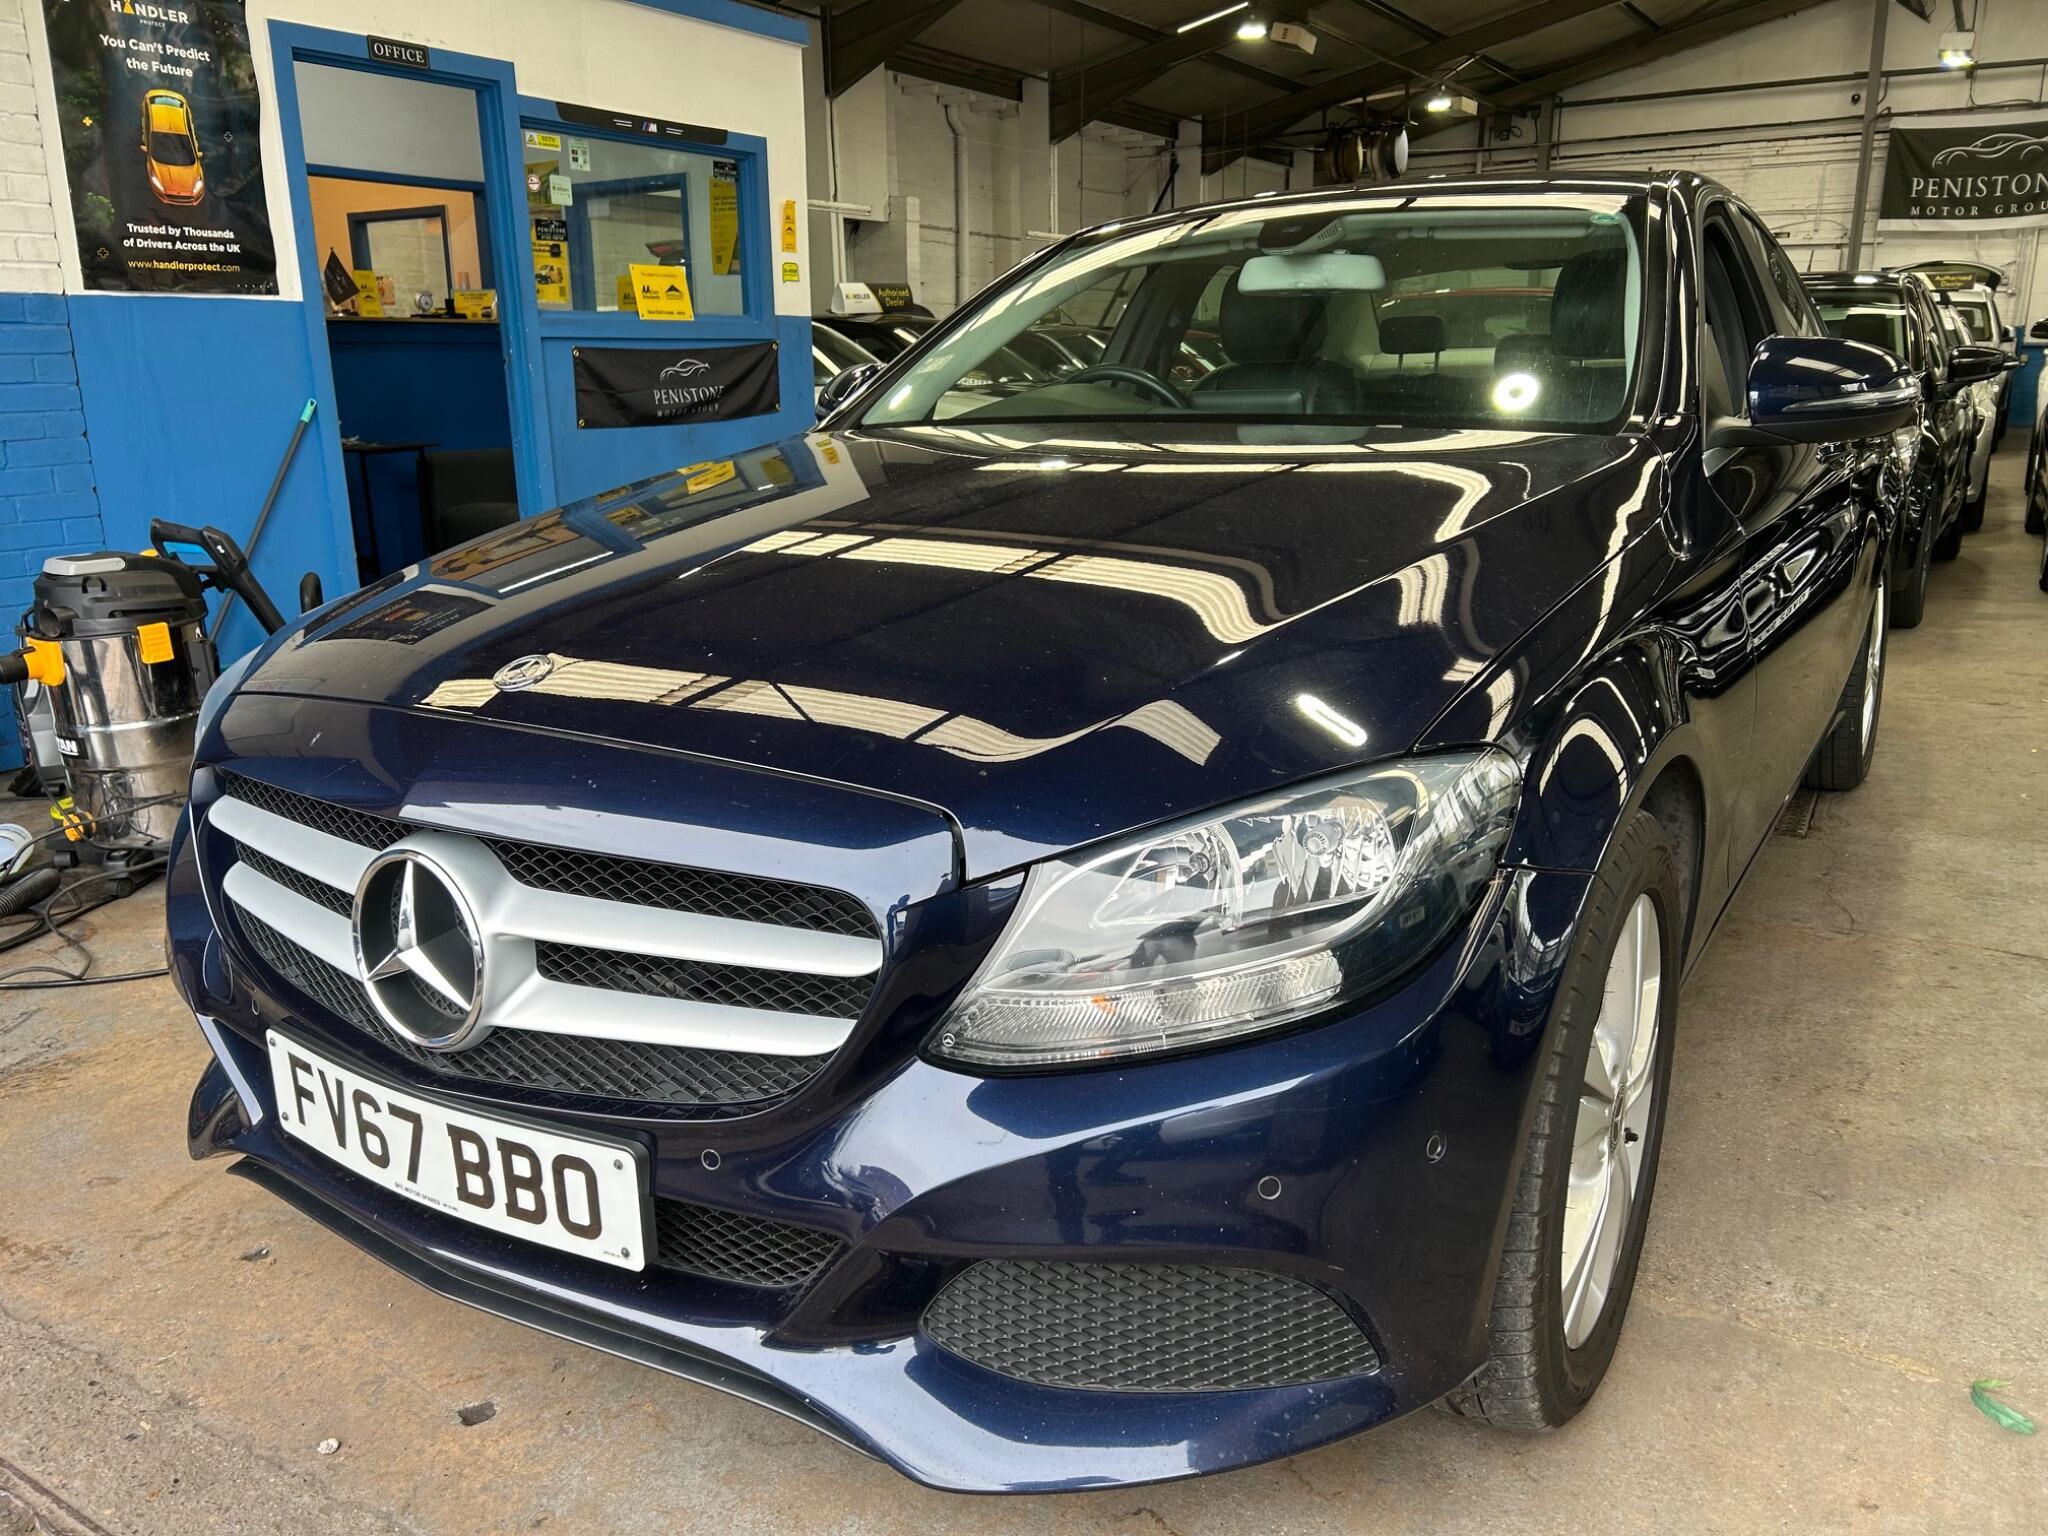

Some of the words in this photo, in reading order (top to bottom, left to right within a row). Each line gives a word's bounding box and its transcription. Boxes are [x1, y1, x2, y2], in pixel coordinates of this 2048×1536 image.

[99, 34, 126, 48] You
[128, 39, 163, 54] Can't
[165, 44, 211, 62] Predict
[373, 42, 425, 64] OFFICE
[126, 58, 148, 70] the
[151, 61, 193, 77] Future
[1910, 206, 1979, 216] MOTOR
[126, 223, 166, 234] Trusted
[167, 225, 181, 237] by
[183, 226, 235, 239] Thousands
[123, 238, 134, 247] of
[136, 238, 173, 250] Drivers
[174, 241, 208, 251] Across
[209, 242, 225, 252] the
[226, 243, 241, 253] UK
[127, 260, 240, 272] www.handlerprotect.com
[287, 1052, 424, 1185] FV67
[446, 1123, 604, 1241] BBO
